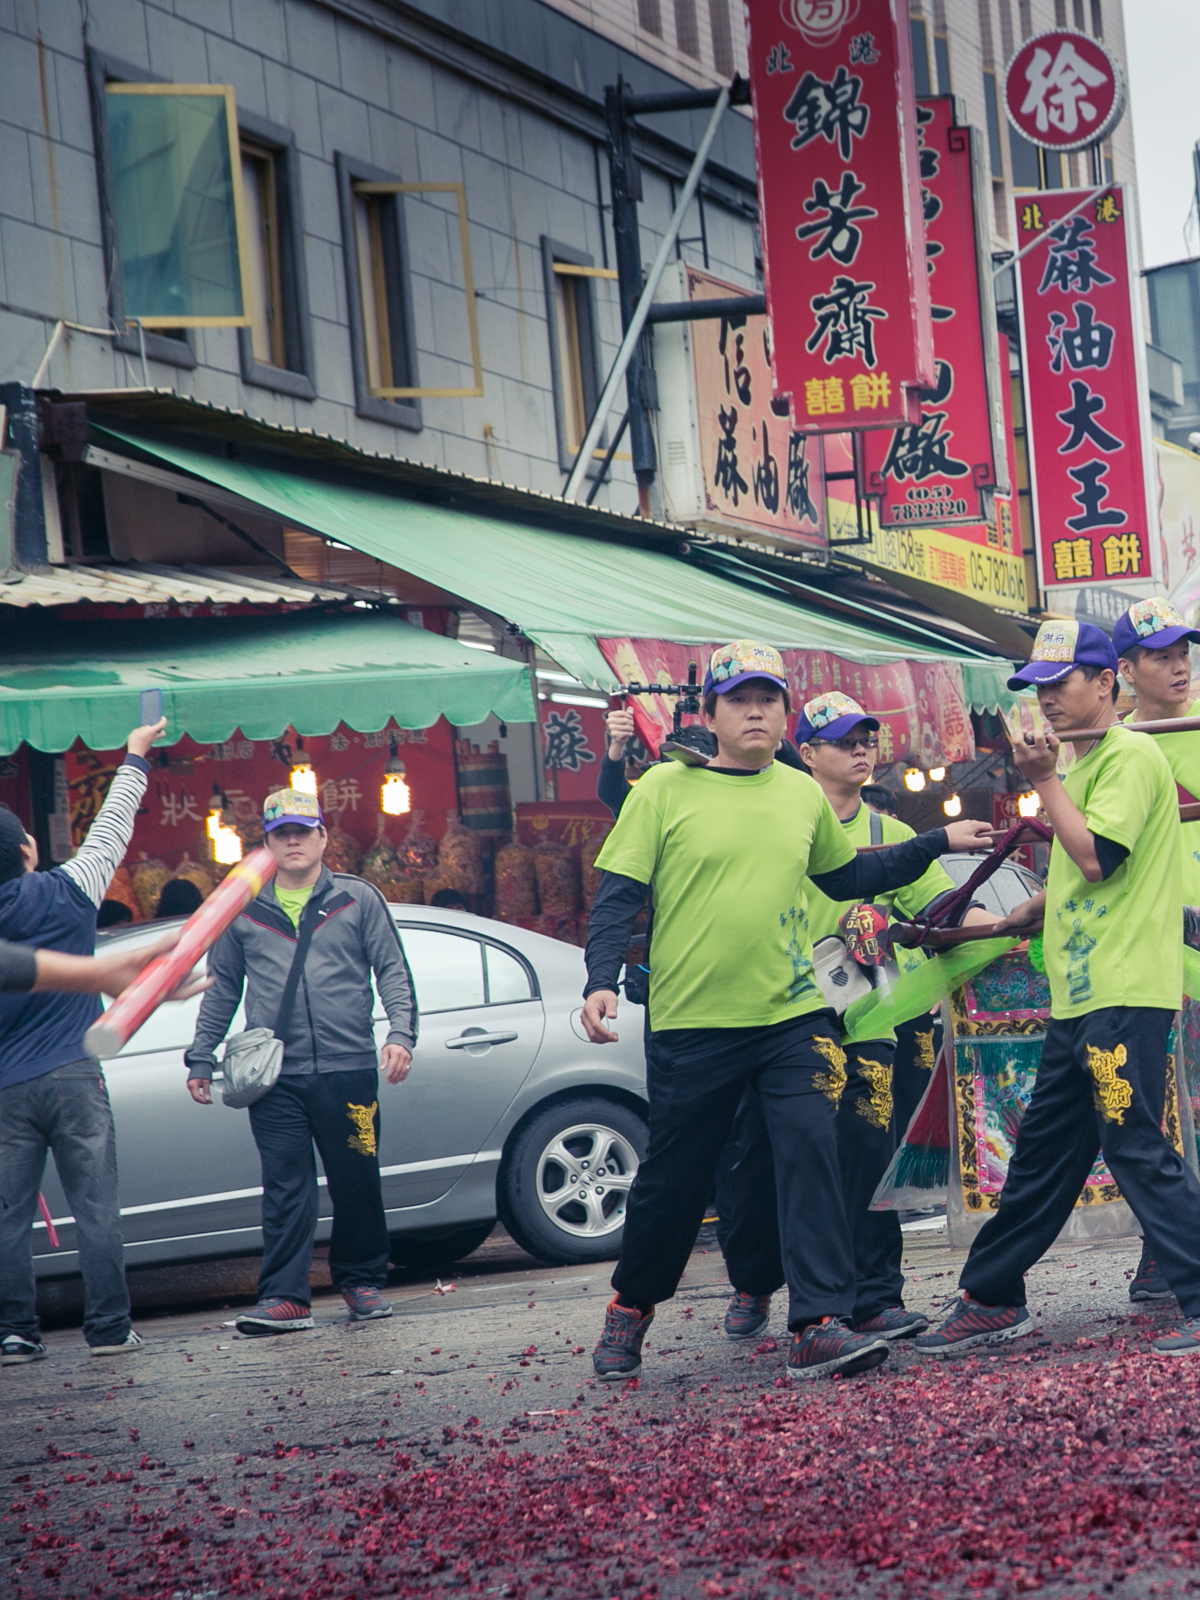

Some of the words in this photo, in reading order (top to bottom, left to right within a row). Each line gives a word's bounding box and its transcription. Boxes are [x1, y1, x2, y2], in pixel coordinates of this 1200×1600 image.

[1020, 41, 1108, 135] 徐
[783, 66, 888, 370] 錦芳齋
[805, 370, 891, 416] 囍餅
[891, 499, 967, 521] 7832320
[906, 486, 953, 501] (05)
[1051, 533, 1142, 580] 囍餅
[160, 777, 363, 826] 狀元餅
[1093, 1054, 1131, 1107] 謝府
